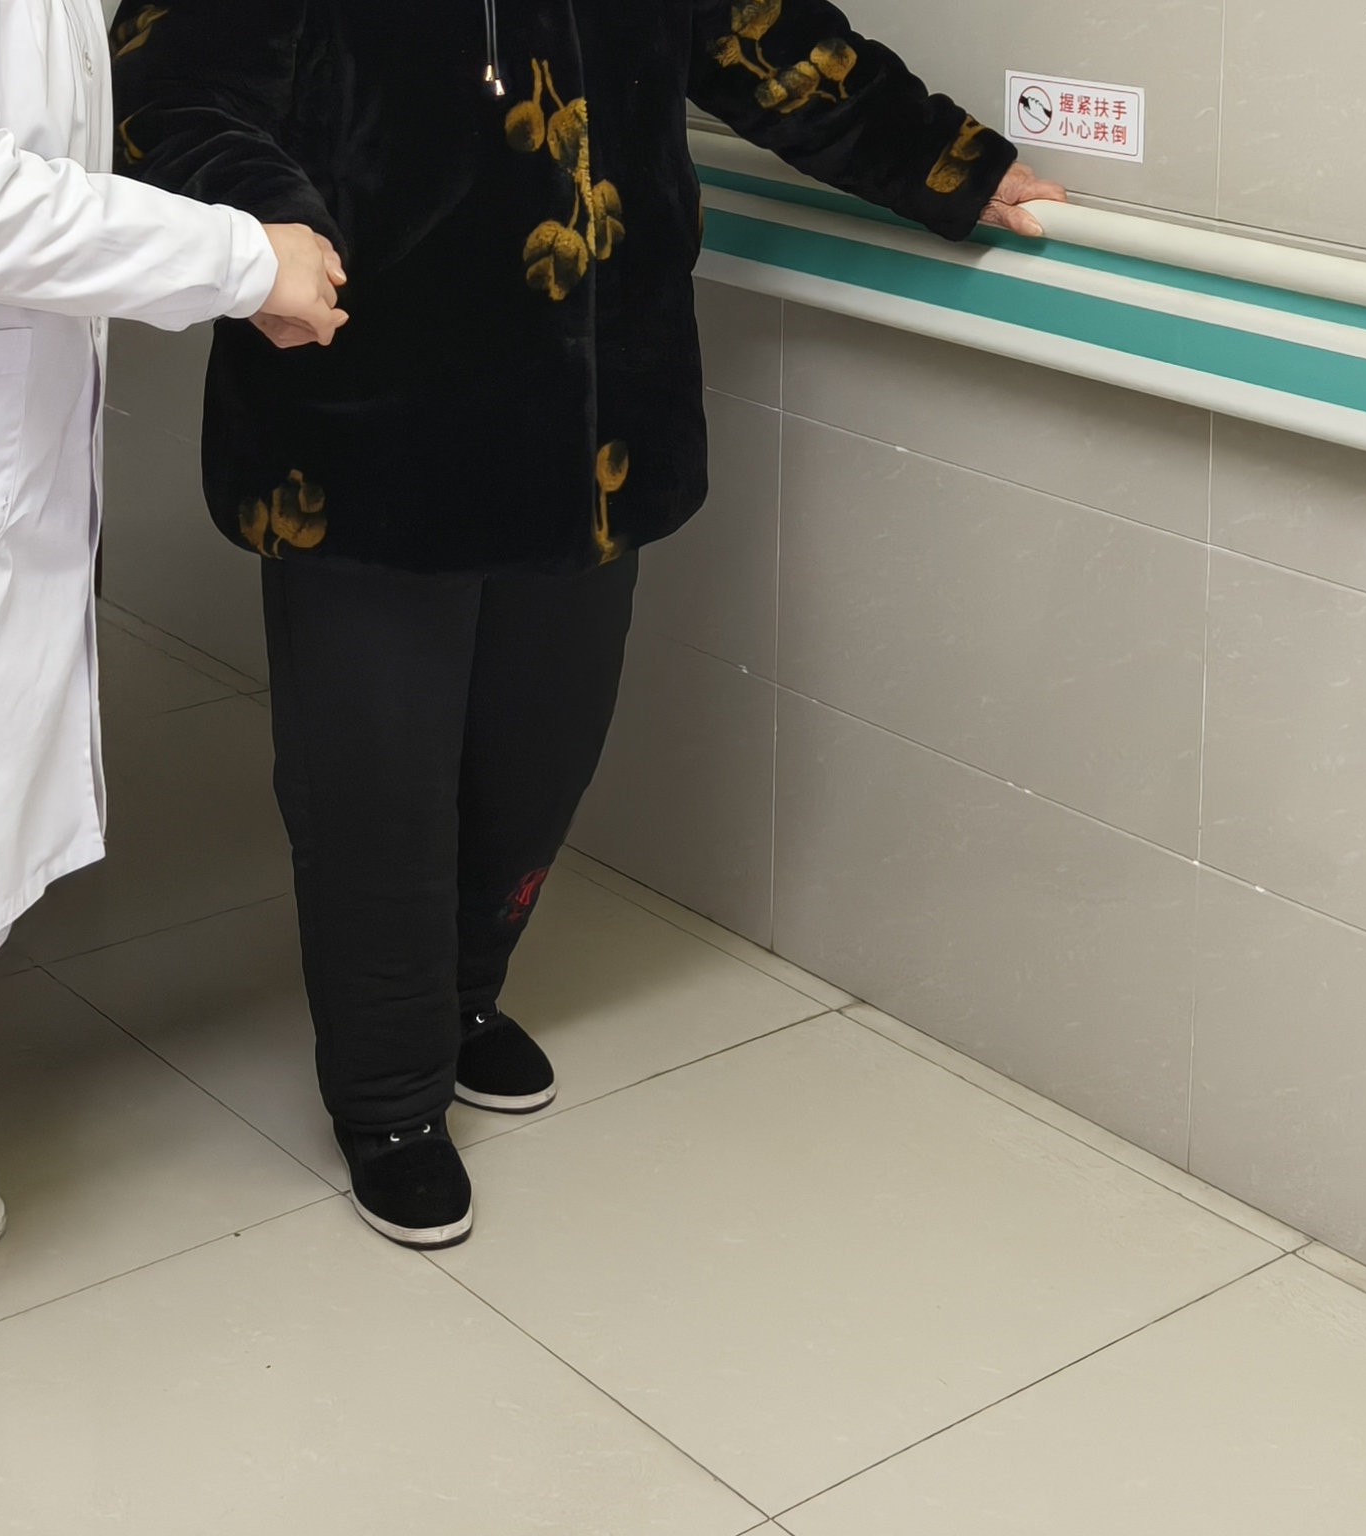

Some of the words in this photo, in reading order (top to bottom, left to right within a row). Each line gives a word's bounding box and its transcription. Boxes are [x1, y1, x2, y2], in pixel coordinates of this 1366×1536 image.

[1059, 92, 1127, 120] 握紧扶手
[1059, 117, 1127, 145] 小心跌倒
